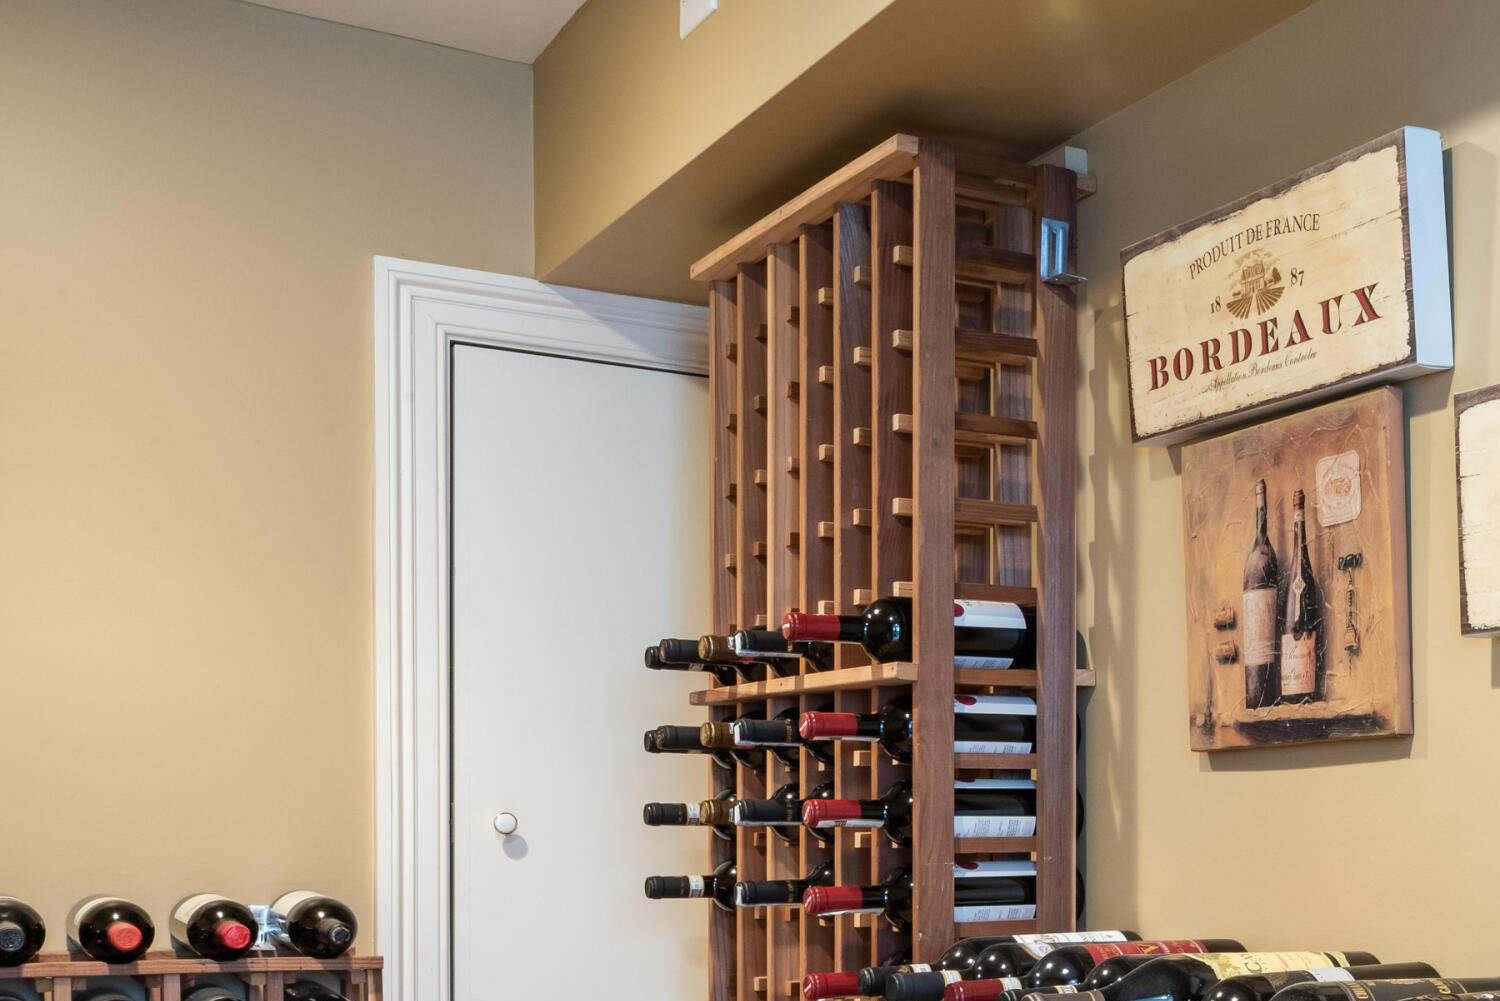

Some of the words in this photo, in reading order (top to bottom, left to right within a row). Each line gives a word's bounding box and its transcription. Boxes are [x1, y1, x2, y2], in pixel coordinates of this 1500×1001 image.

[1188, 232, 1244, 280] PRODUIT
[1246, 224, 1263, 246] DE
[1265, 213, 1321, 239] FRANCE
[1290, 267, 1305, 287] 87
[1209, 296, 1222, 315] 18
[1148, 282, 1384, 392] BORDEAUX
